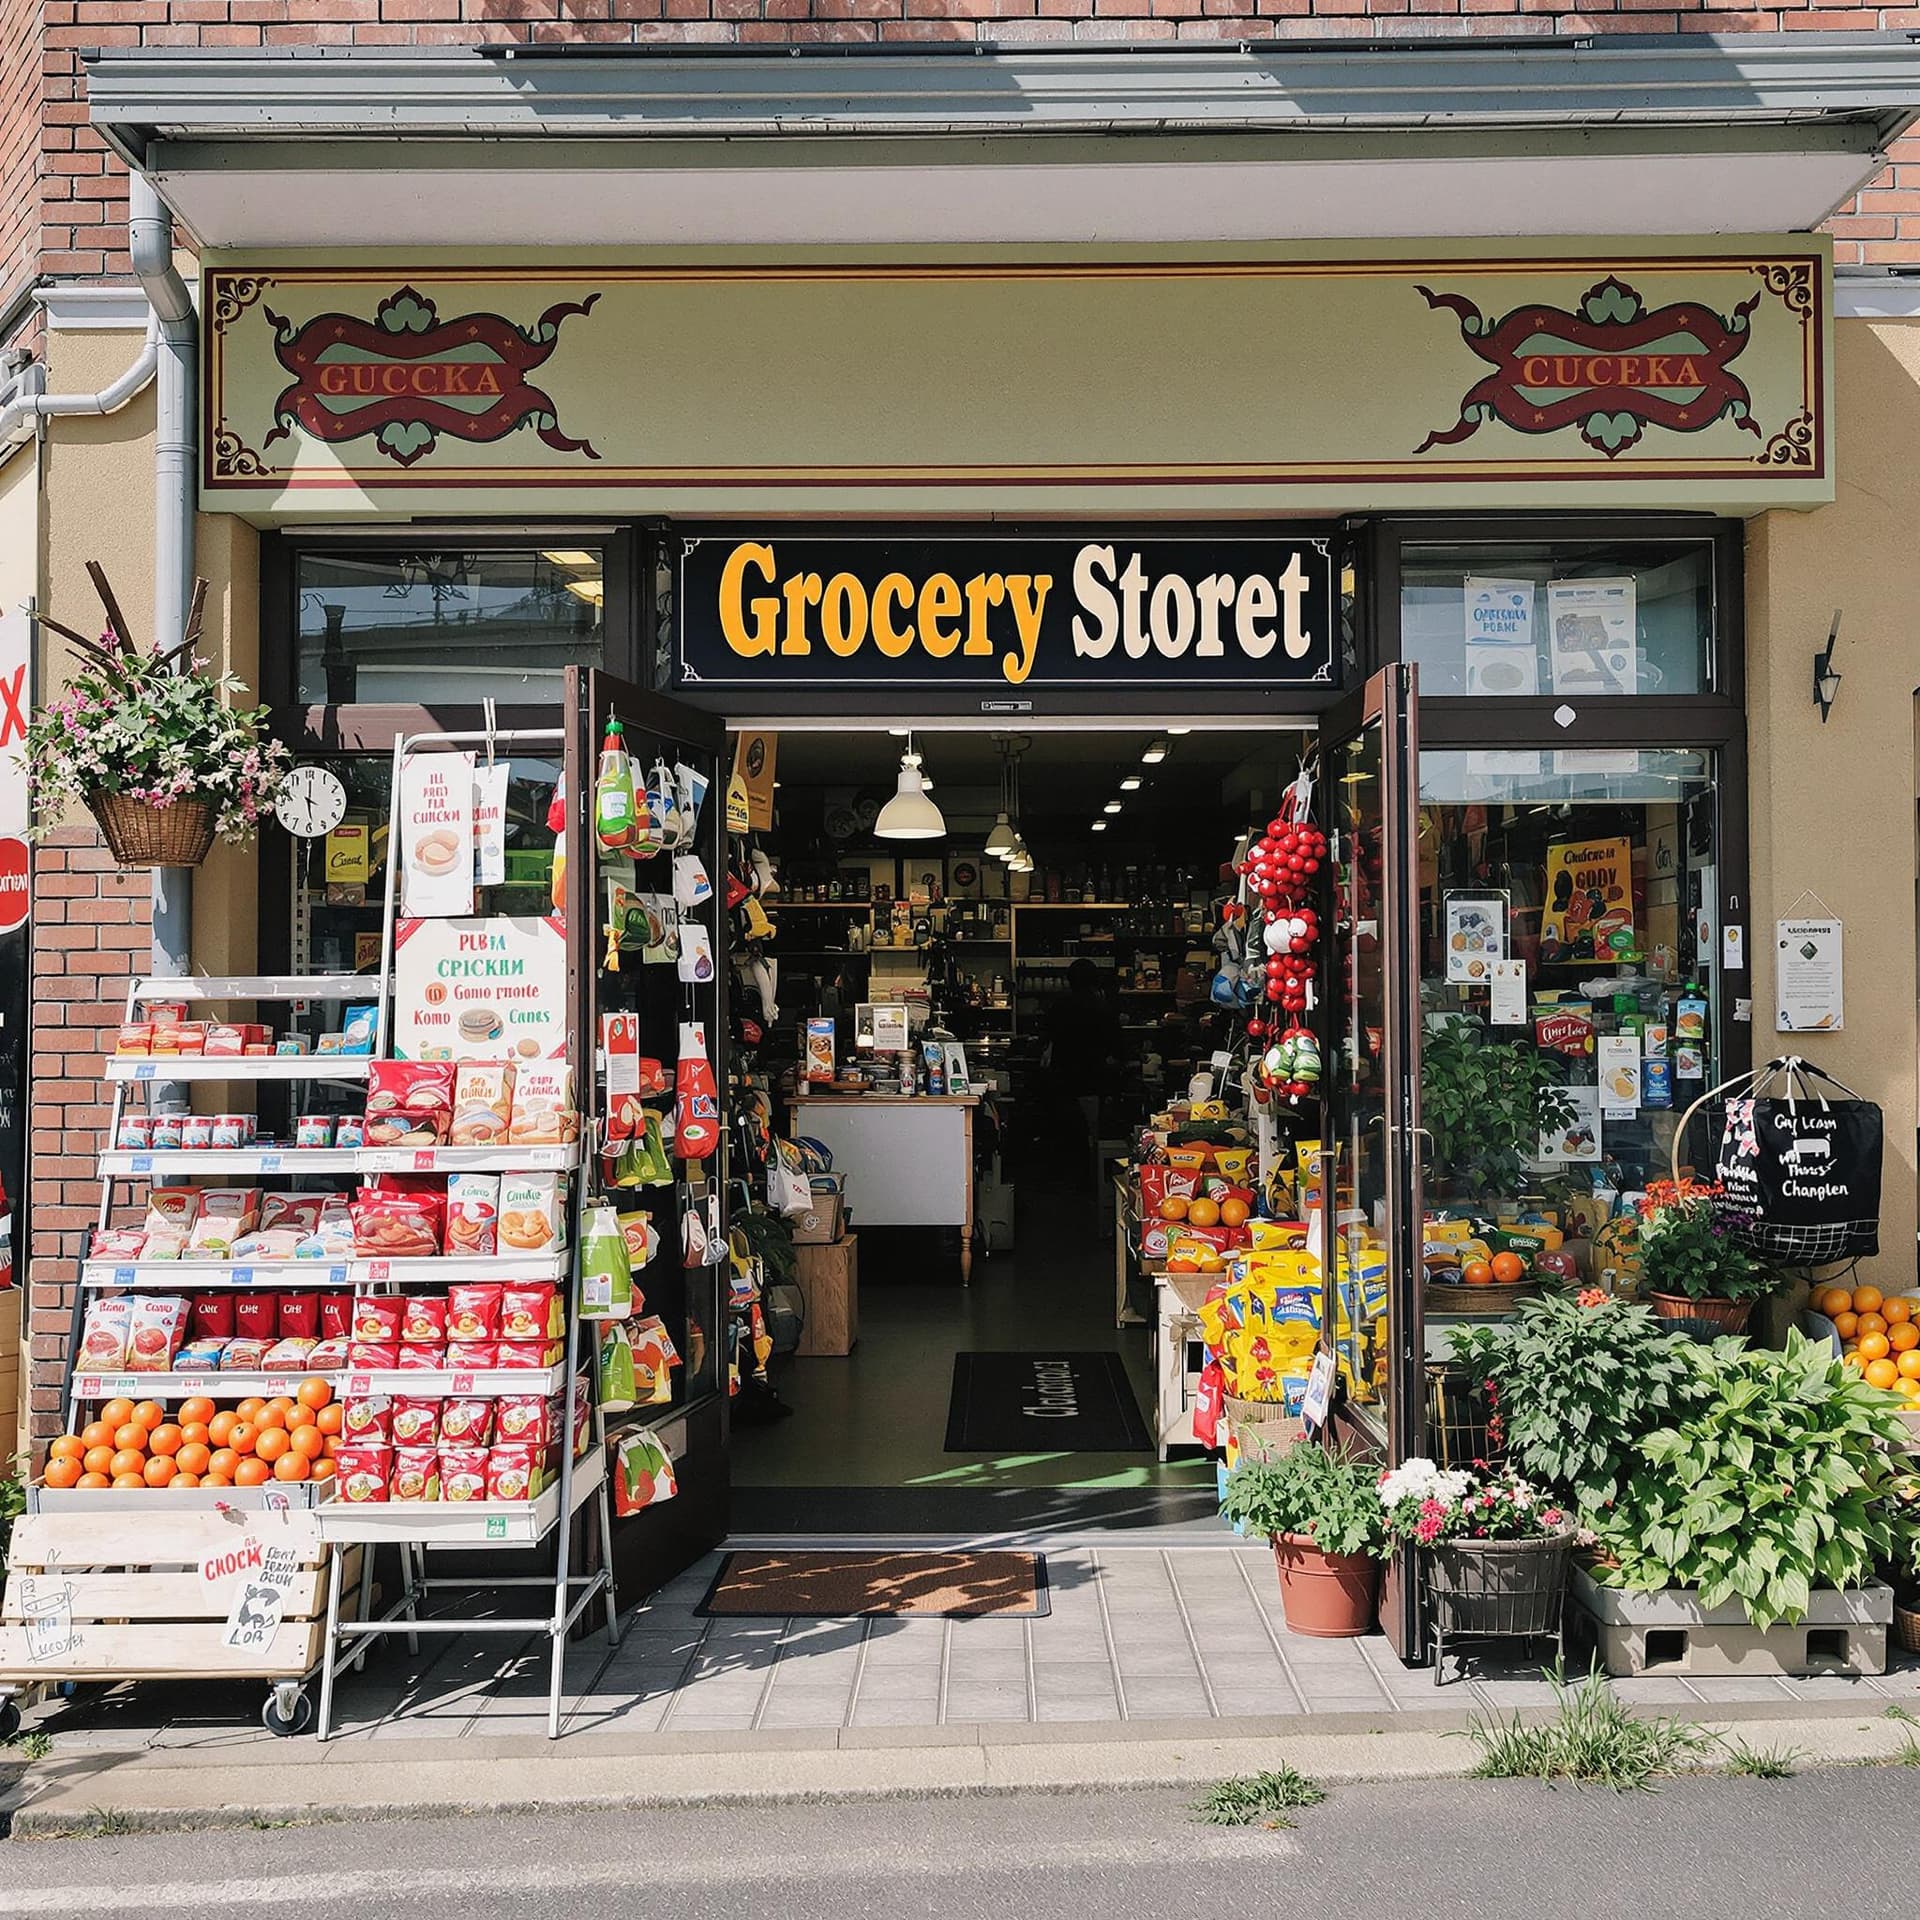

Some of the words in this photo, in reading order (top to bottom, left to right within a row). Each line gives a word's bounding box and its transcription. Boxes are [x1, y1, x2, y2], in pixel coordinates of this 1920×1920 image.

[1522, 355, 1703, 386] CUCEKA
[719, 542, 1053, 684] Grocery
[1072, 544, 1311, 659] Storet
